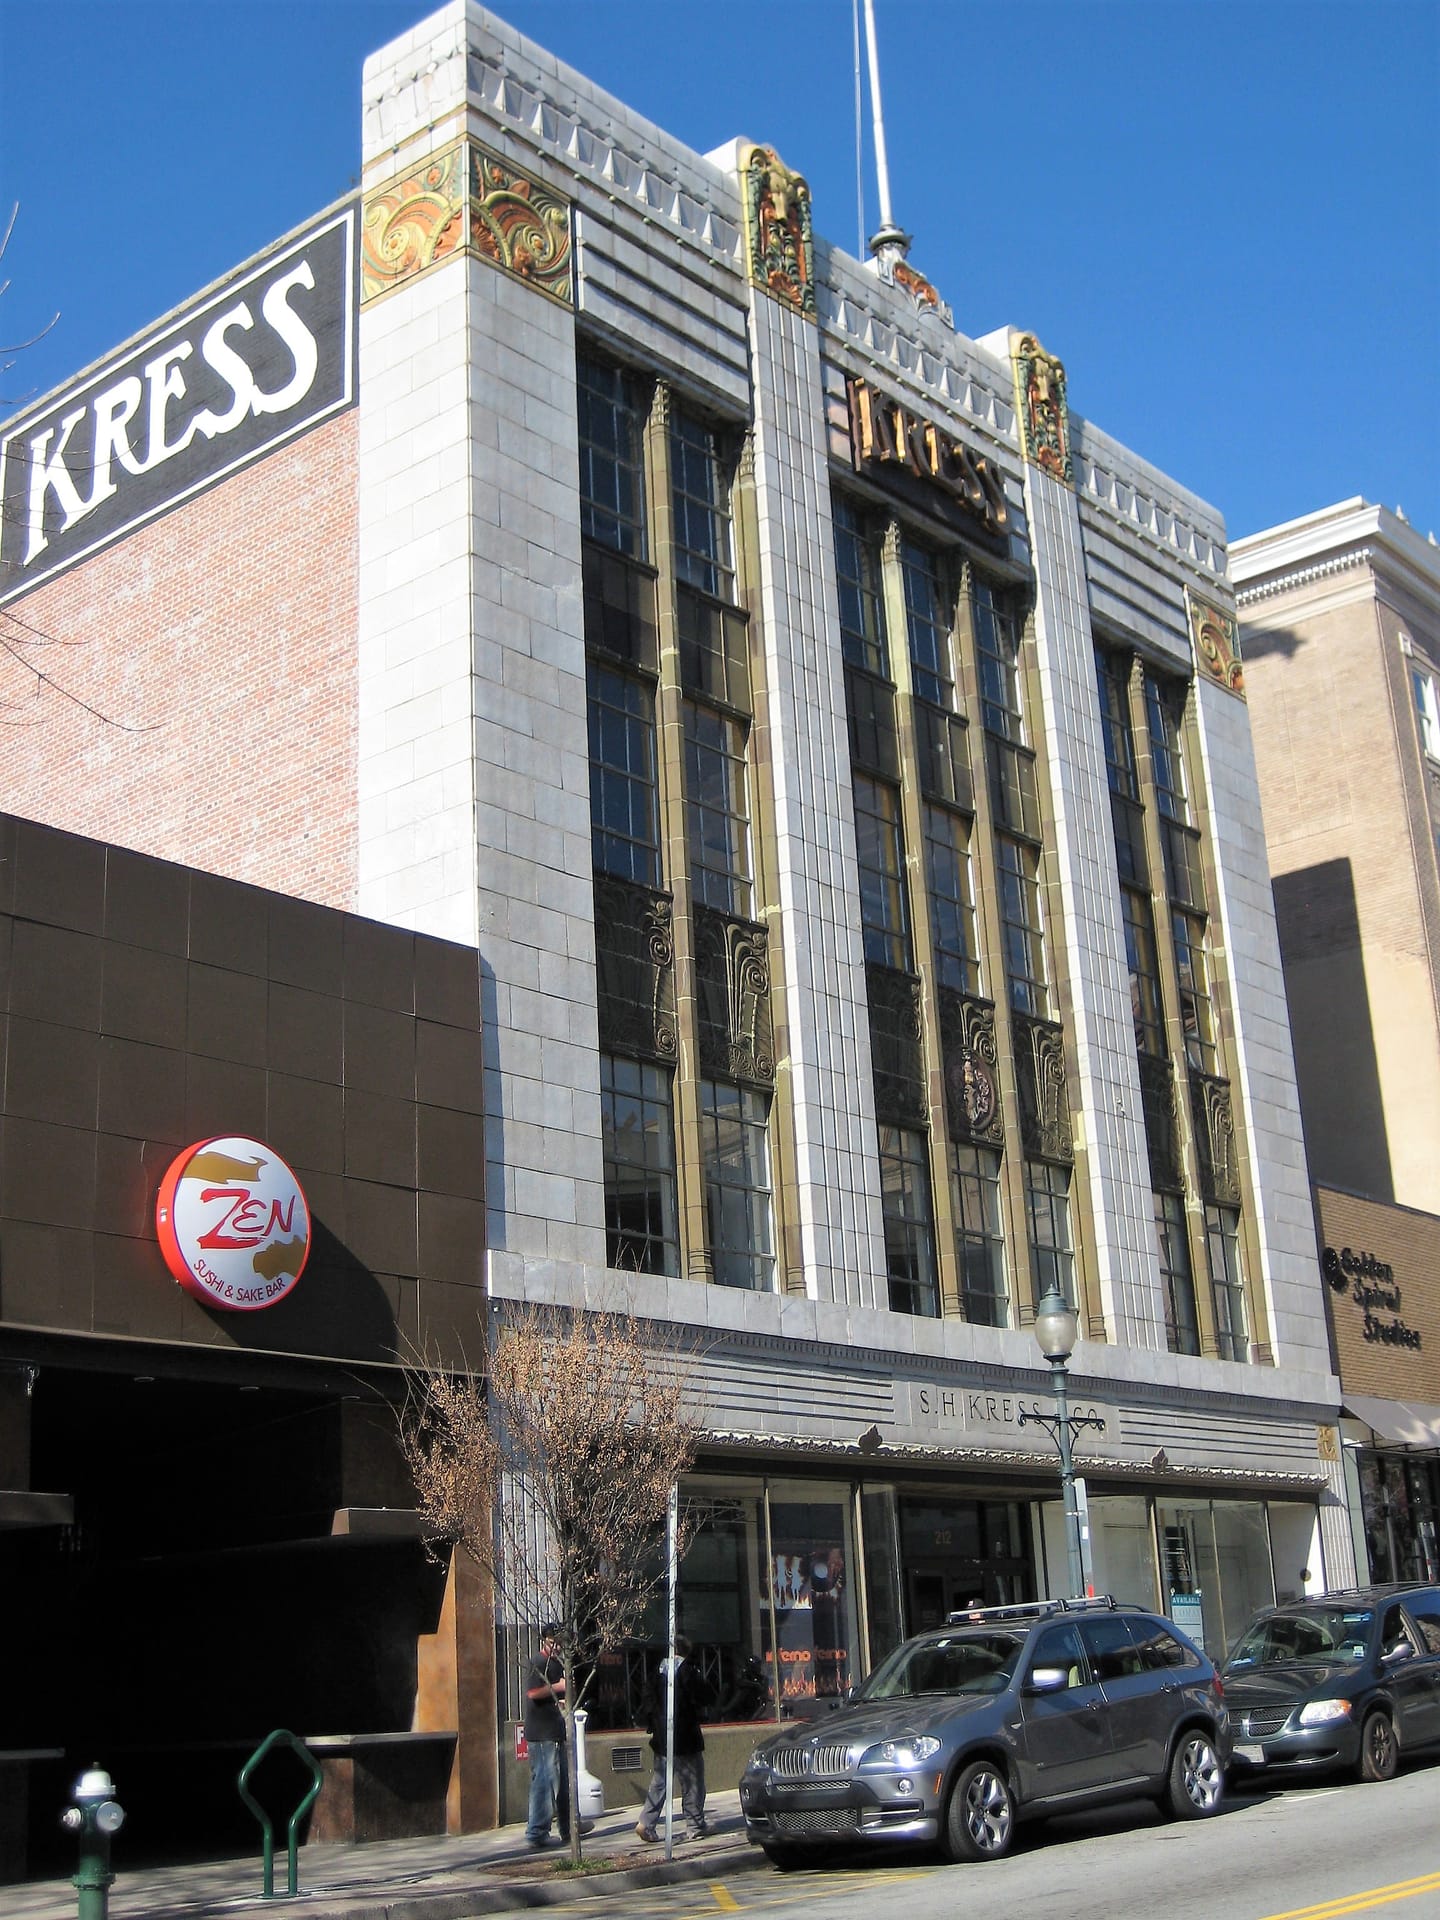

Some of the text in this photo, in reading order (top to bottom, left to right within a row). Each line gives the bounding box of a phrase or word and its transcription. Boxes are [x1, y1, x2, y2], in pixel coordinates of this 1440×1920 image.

[24, 260, 319, 567] KRESS
[847, 378, 1010, 537] KRESS
[197, 1188, 296, 1250] ZEN
[193, 1259, 286, 1302] SUSHI & SAKE BAR
